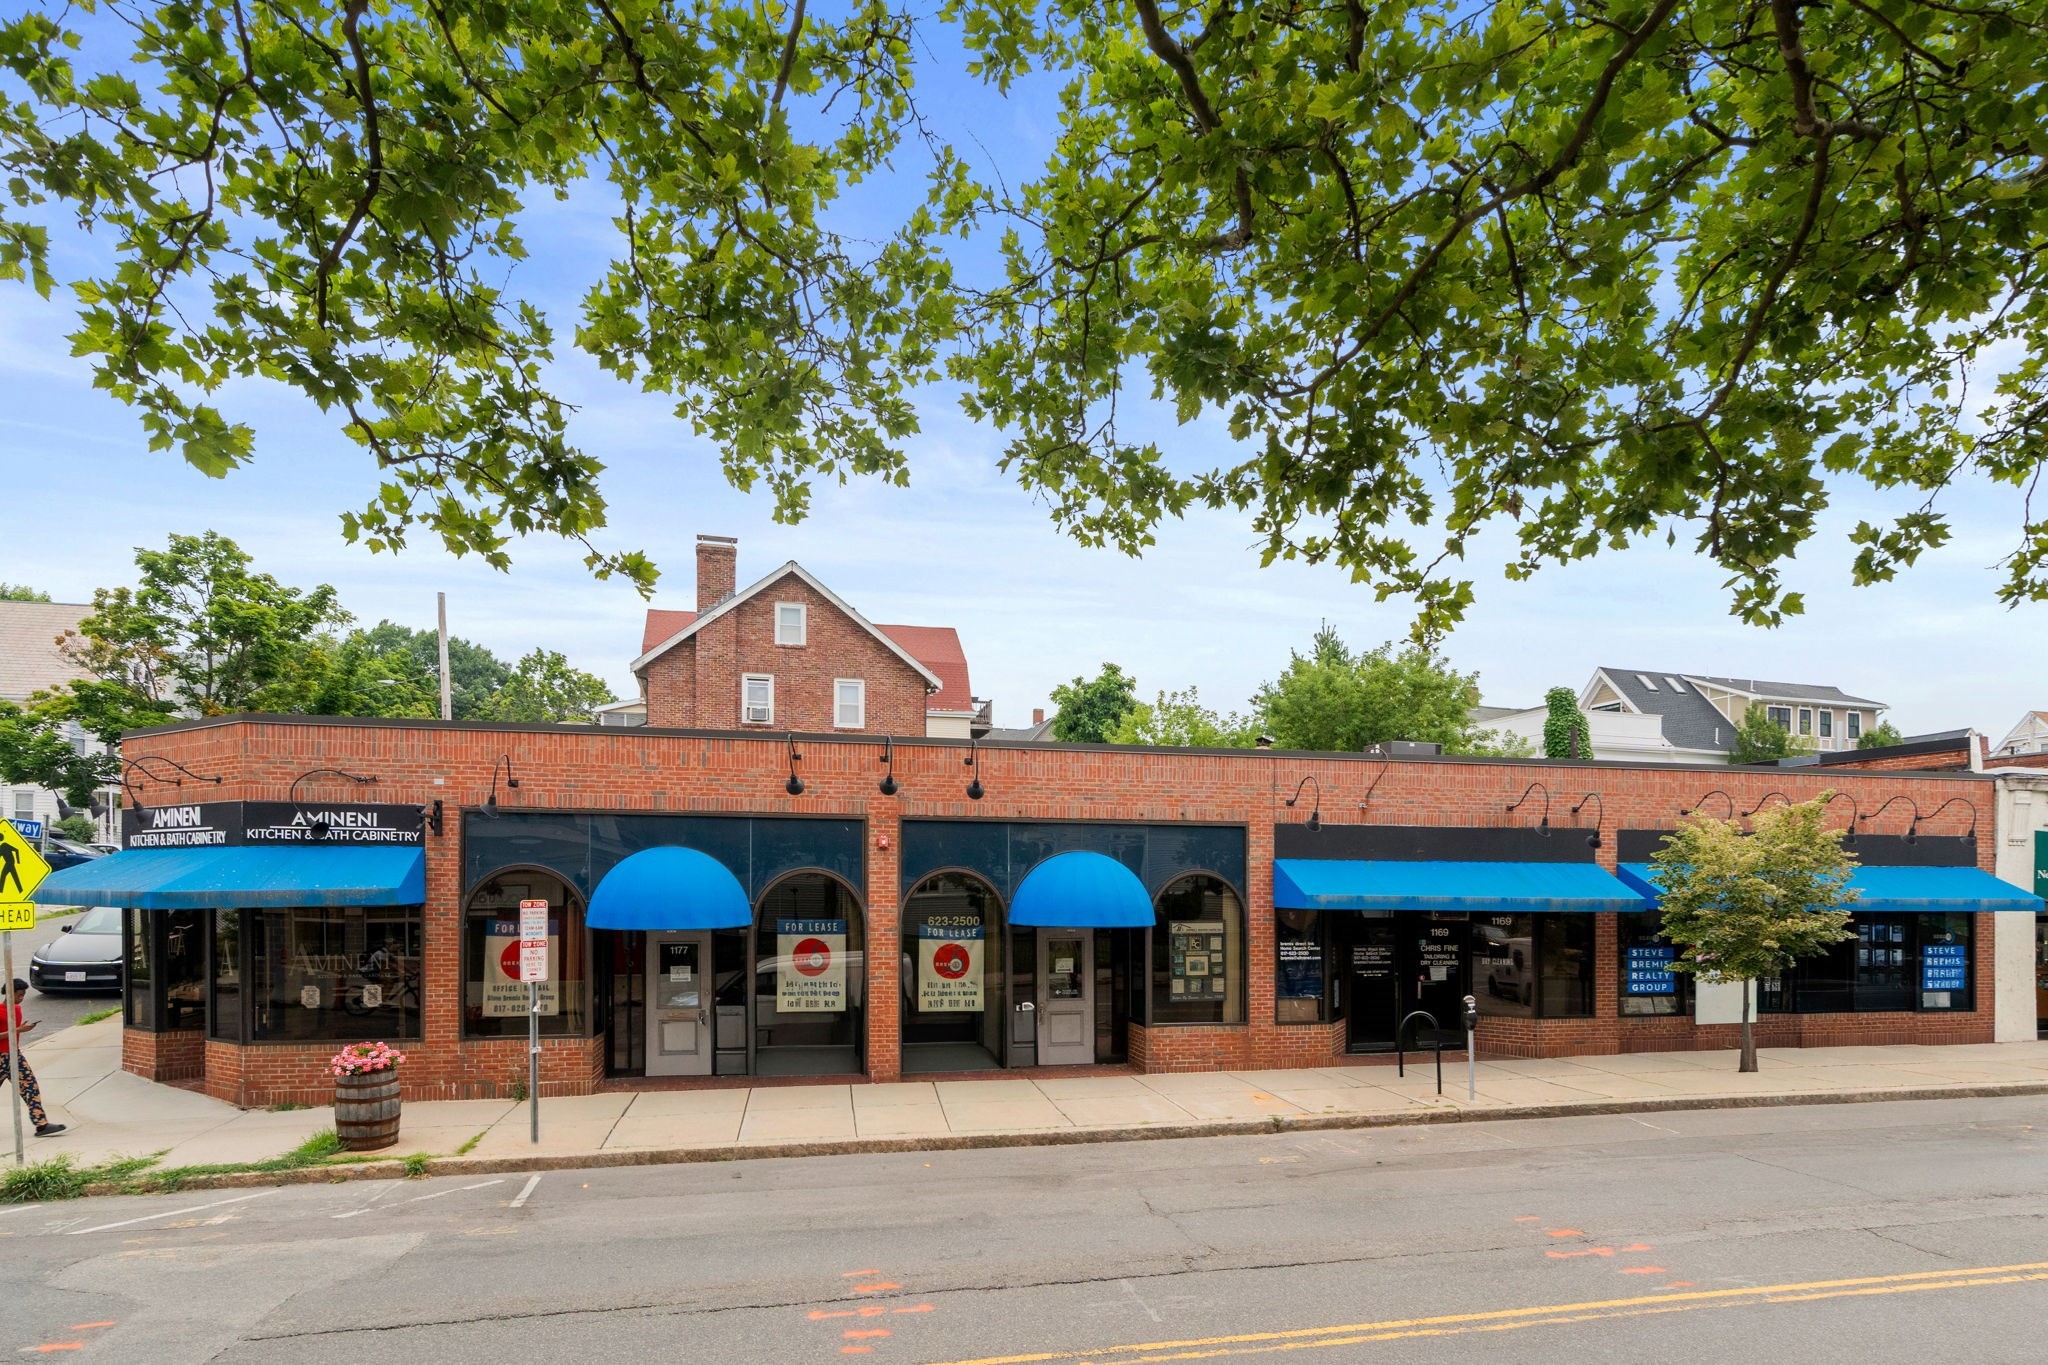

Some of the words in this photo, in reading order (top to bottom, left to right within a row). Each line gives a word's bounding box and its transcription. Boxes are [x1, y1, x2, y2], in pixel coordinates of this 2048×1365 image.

[153, 806, 201, 828] AMINENI
[291, 811, 378, 827] AMINENI
[130, 834, 159, 847] KITCHEN
[160, 833, 166, 846] &
[166, 832, 186, 846] BATH
[186, 830, 227, 845] CABINETRY
[246, 828, 301, 840] KITCHEN
[304, 830, 313, 840] &
[322, 830, 349, 841] ATH
[352, 830, 420, 842] CABINETRY
[927, 915, 980, 927] 623-2500
[1491, 916, 1512, 926] 1169
[494, 923, 516, 934] FOR
[785, 922, 803, 932] FOR
[809, 922, 838, 931] LEASE
[927, 927, 944, 937] FOR
[949, 928, 977, 938] LEASE
[1430, 928, 1449, 937] 1169
[670, 946, 688, 955] 1177
[1420, 944, 1442, 952] CHRIS
[1443, 944, 1459, 952] FINE
[1632, 949, 1664, 957] STEVE
[1927, 947, 1956, 955] STEVE
[1632, 960, 1669, 969] BREMIS
[1632, 972, 1670, 980] REALTY
[1632, 983, 1667, 991] GROUP
